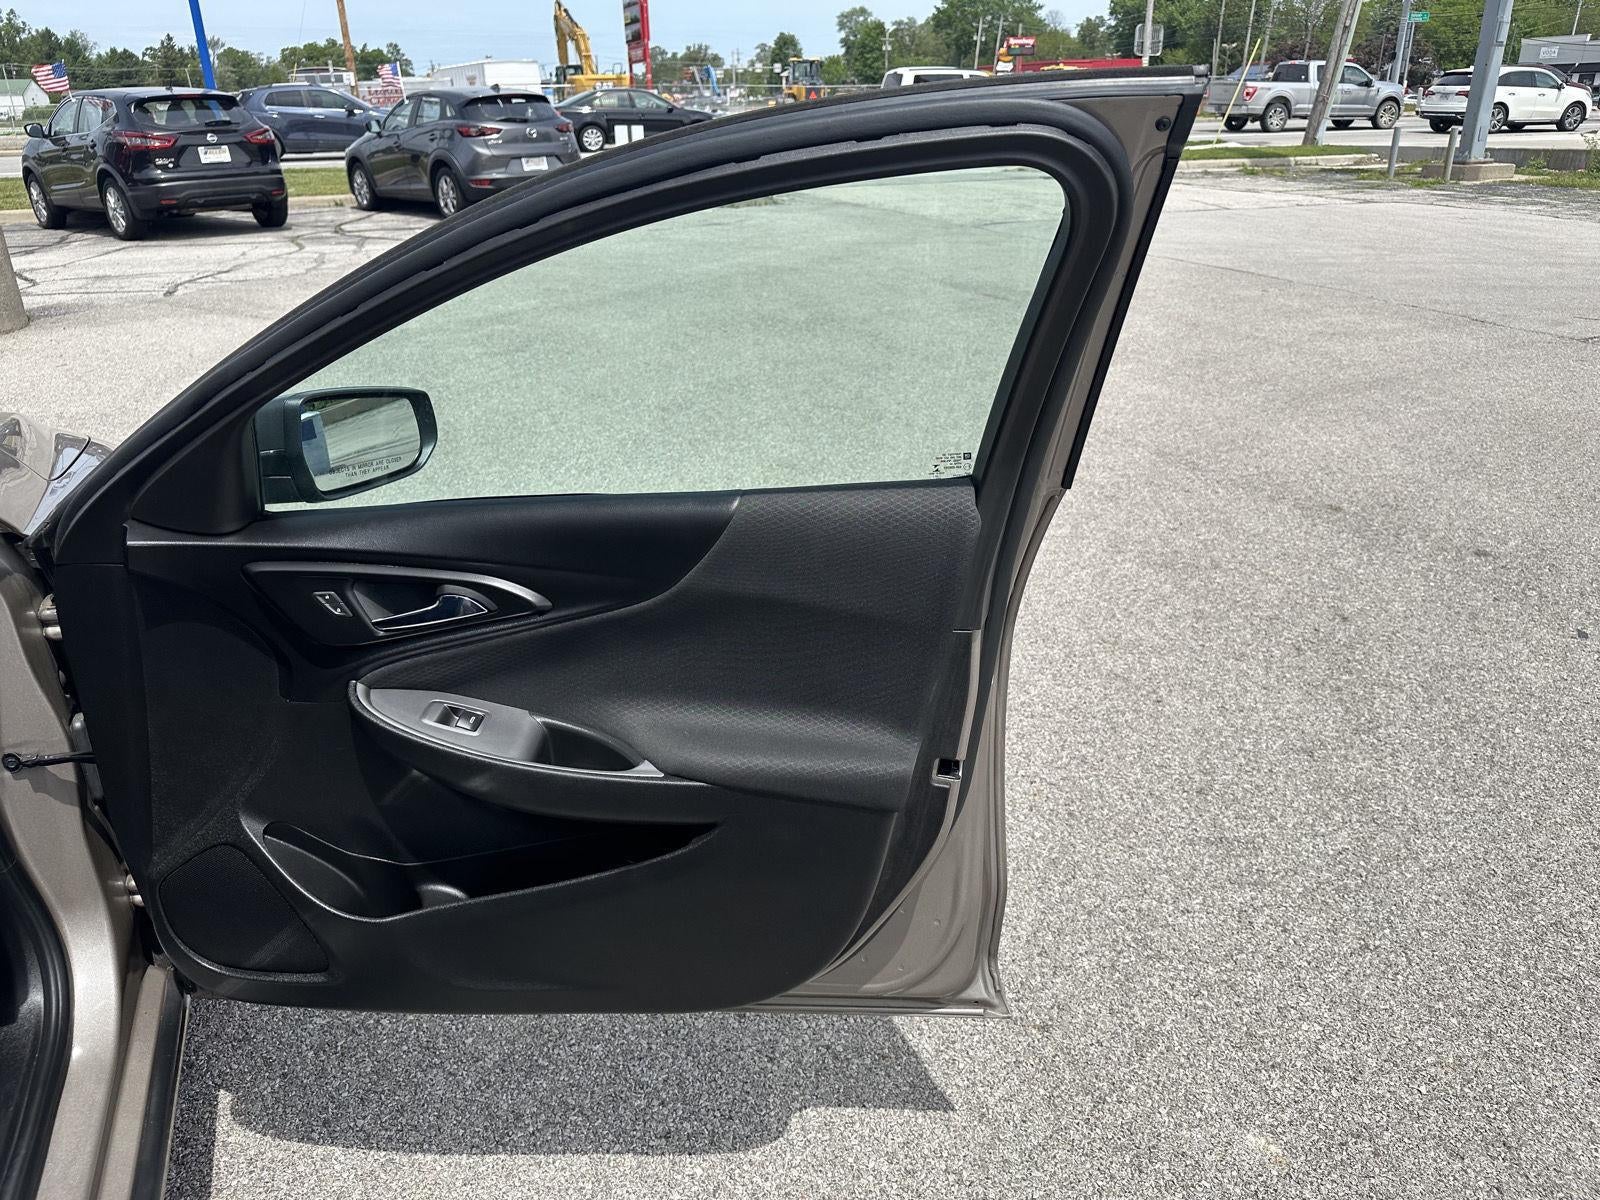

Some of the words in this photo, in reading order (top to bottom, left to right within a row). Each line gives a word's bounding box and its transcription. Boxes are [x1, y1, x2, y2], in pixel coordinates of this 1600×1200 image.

[329, 466, 350, 475] OBJECTS
[357, 461, 374, 470] MIRROR
[385, 456, 401, 464] CLOSER
